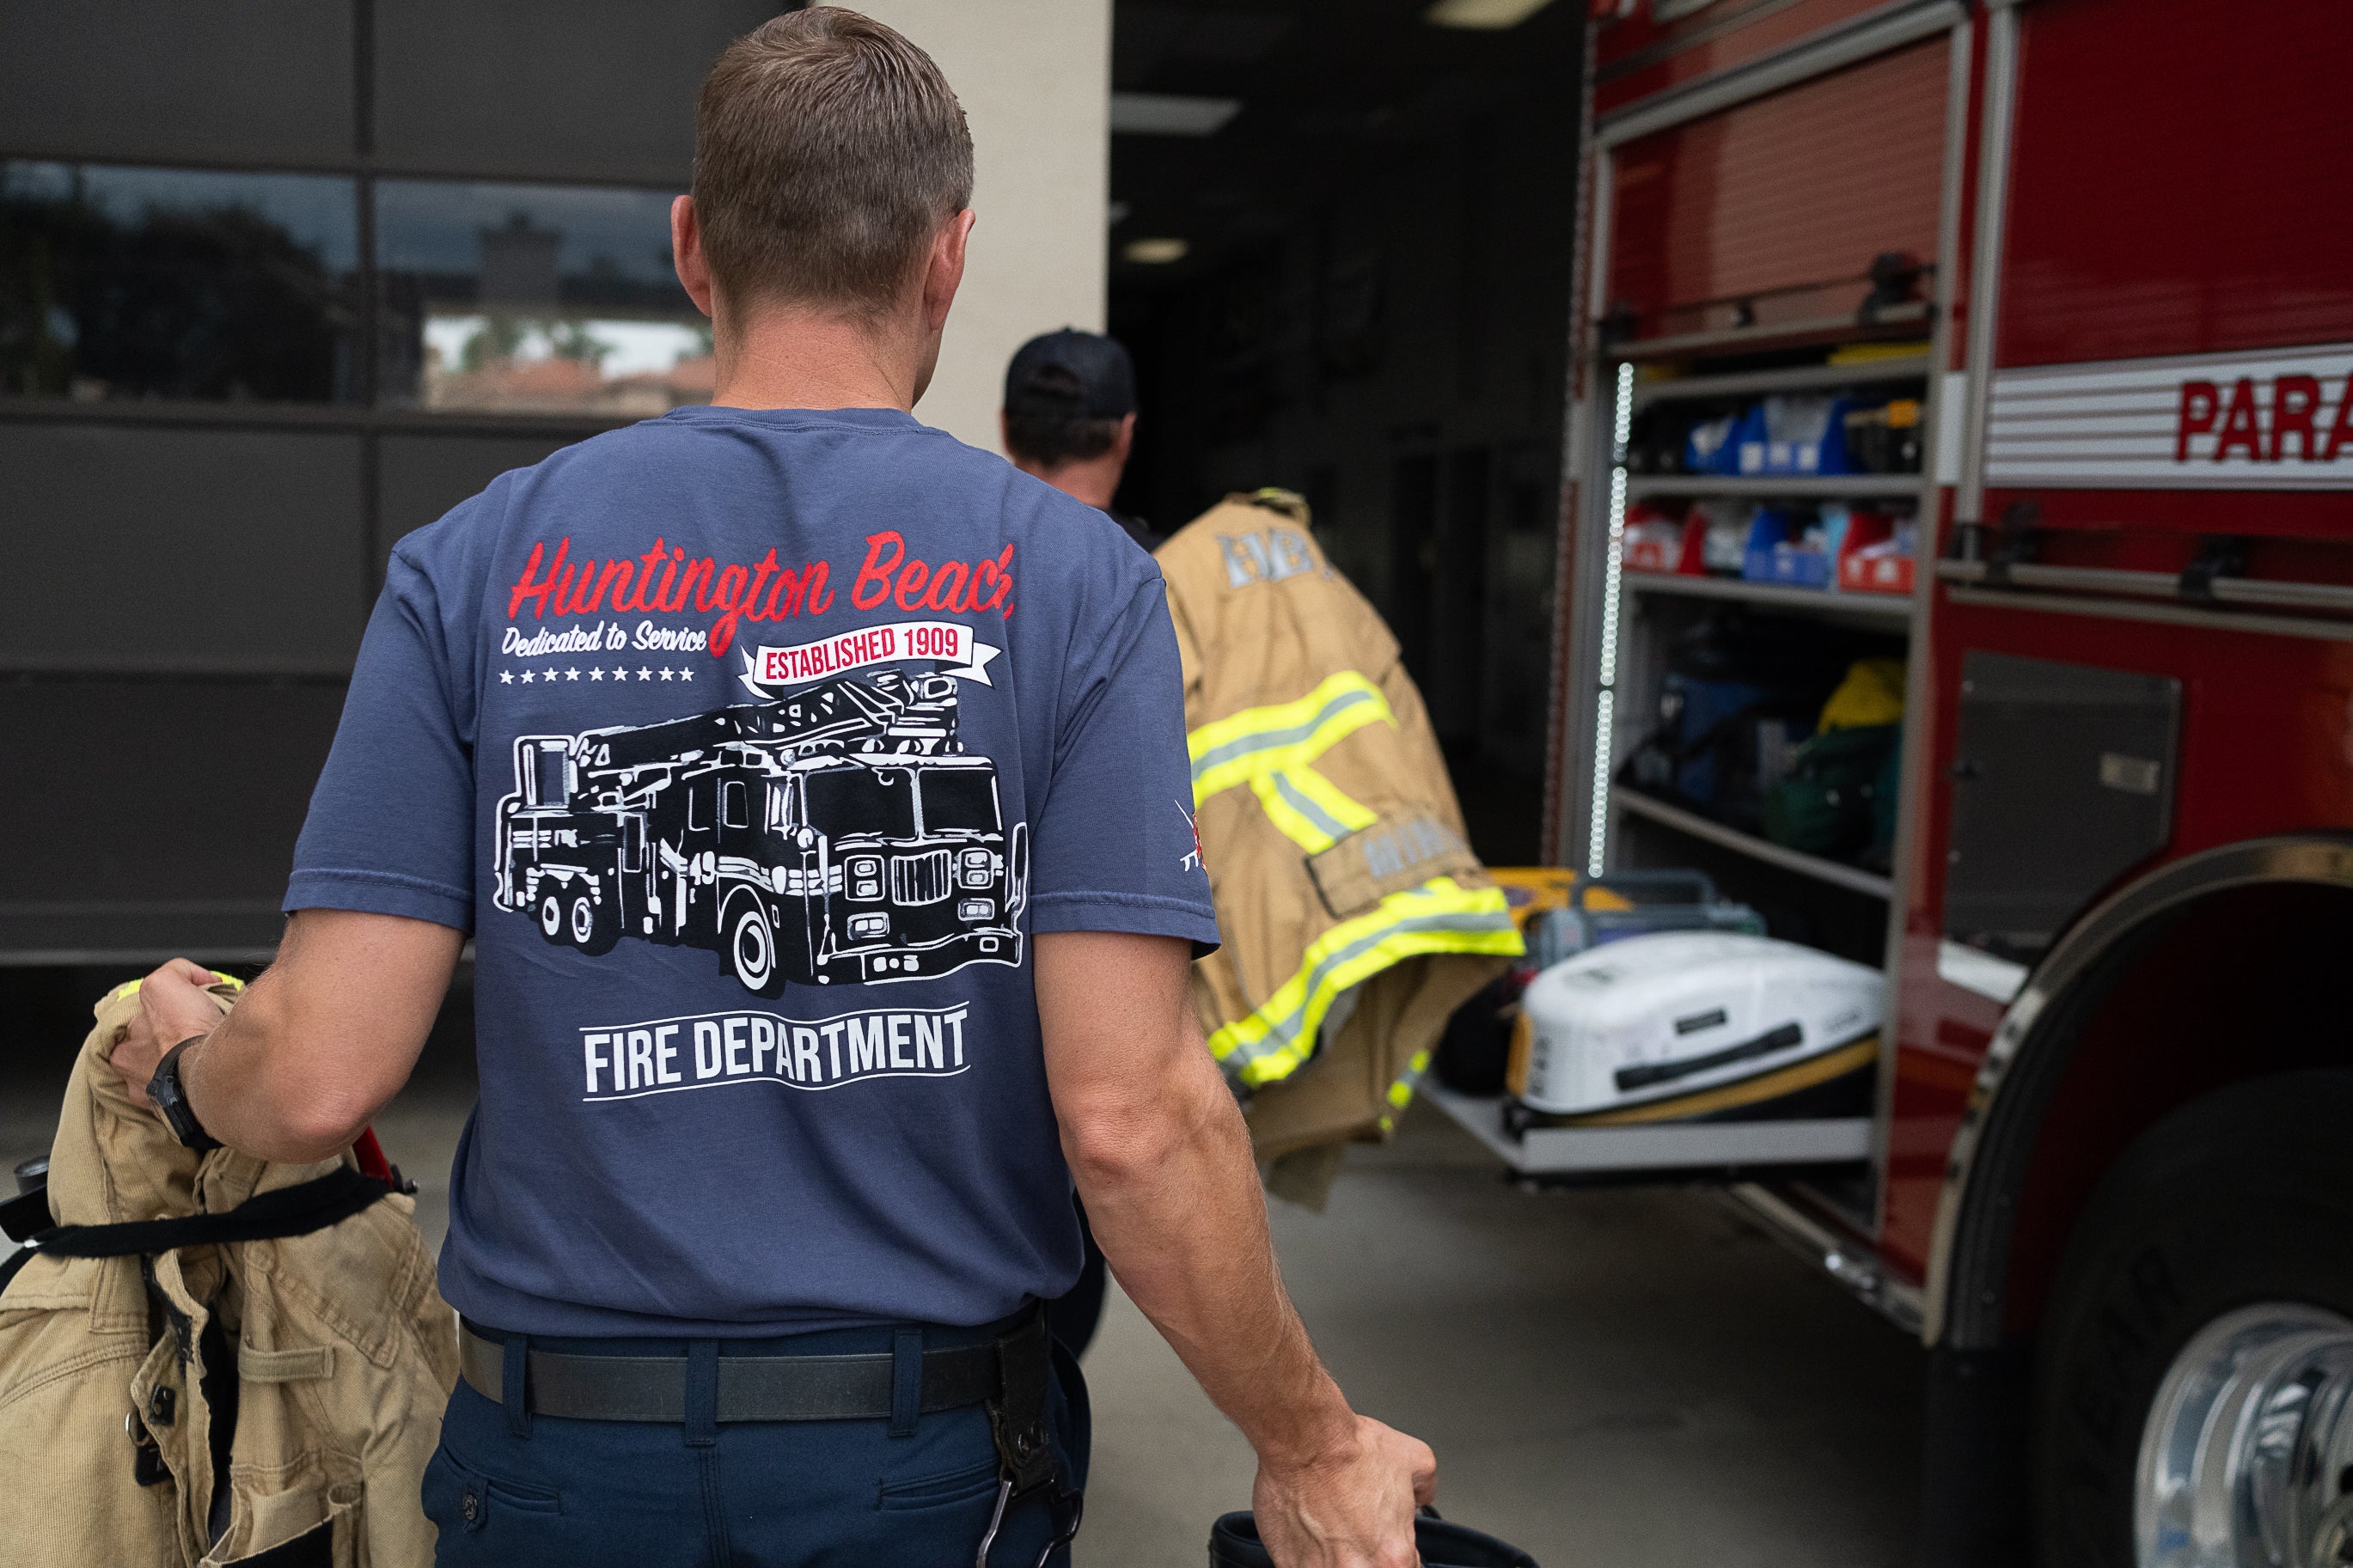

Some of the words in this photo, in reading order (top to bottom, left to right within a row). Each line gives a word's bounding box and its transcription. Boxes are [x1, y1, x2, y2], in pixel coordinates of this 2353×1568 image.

[507, 535, 836, 659] Huntington
[502, 619, 605, 657] Dedicated
[605, 621, 627, 650] to
[631, 619, 707, 652] Service
[766, 627, 895, 680] ESTABLISHED
[904, 626, 958, 657] 1909
[584, 1024, 682, 1093] FIRE
[694, 1009, 969, 1083] DEPARTMENT
